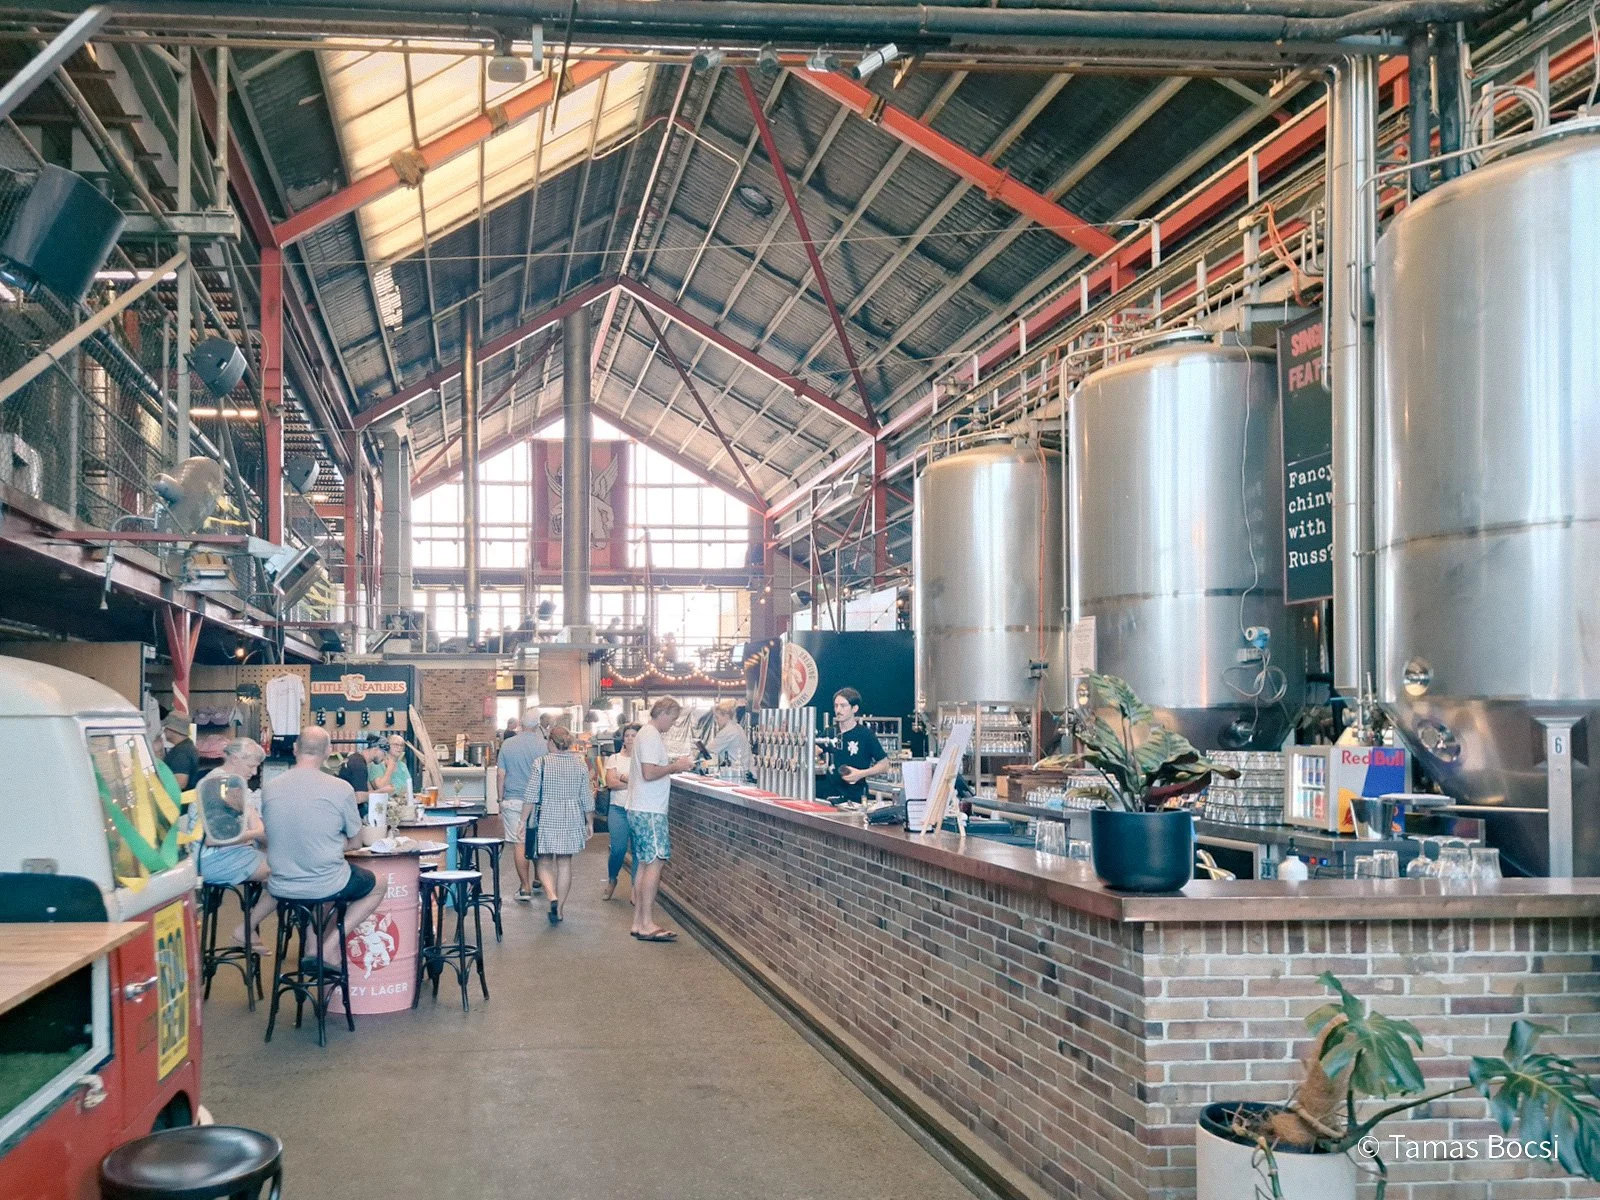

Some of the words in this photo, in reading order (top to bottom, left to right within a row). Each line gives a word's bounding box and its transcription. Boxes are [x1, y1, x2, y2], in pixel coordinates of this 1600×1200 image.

[1288, 518, 1327, 539] with
[313, 683, 343, 693] LITTLE
[1554, 737, 1563, 754] 6
[1342, 750, 1371, 765] Red
[1374, 750, 1405, 767] Bull
[371, 983, 408, 996] LAGER
